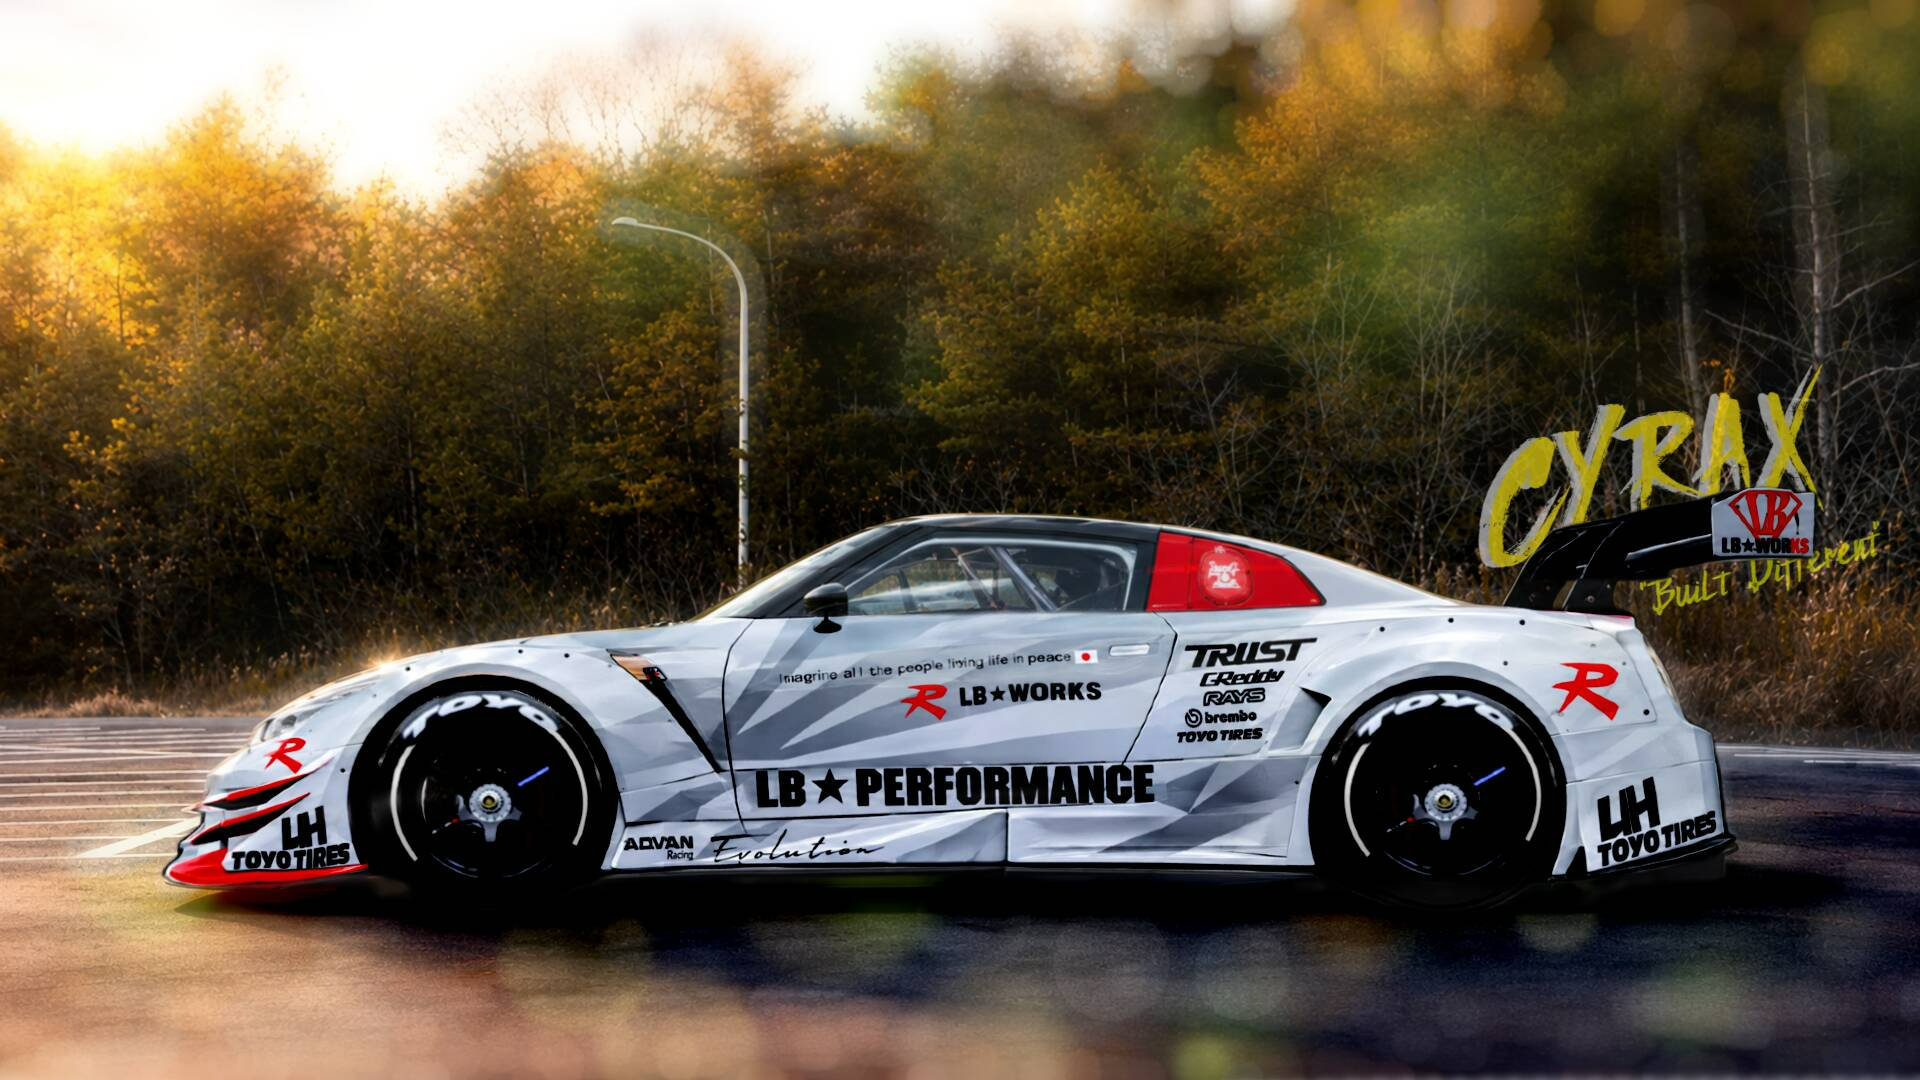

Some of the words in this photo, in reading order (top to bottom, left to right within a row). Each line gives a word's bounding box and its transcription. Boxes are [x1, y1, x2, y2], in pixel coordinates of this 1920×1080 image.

[869, 664, 893, 676] the
[898, 659, 943, 676] people
[988, 654, 1009, 666] life
[1013, 653, 1024, 664] in
[1028, 651, 1071, 666] peace
[1185, 637, 1318, 668] TRUST
[1008, 682, 1102, 703] WORKS
[1203, 687, 1266, 707] RAYS
[401, 694, 558, 740] TOYO
[1205, 709, 1257, 724] brembo
[1356, 693, 1516, 738] TOYO
[1177, 730, 1218, 744] TOYO
[1219, 727, 1264, 742] TIRES
[756, 769, 806, 809] LB
[856, 764, 1156, 807] PERFORMANCE
[624, 835, 694, 850] ADVAN
[711, 829, 885, 863] Evolution
[1597, 829, 1660, 867] TOYO
[1661, 810, 1717, 848] TIRES
[231, 850, 292, 871] TOYO
[293, 842, 350, 870] TIRES
[666, 850, 694, 861] Racing
